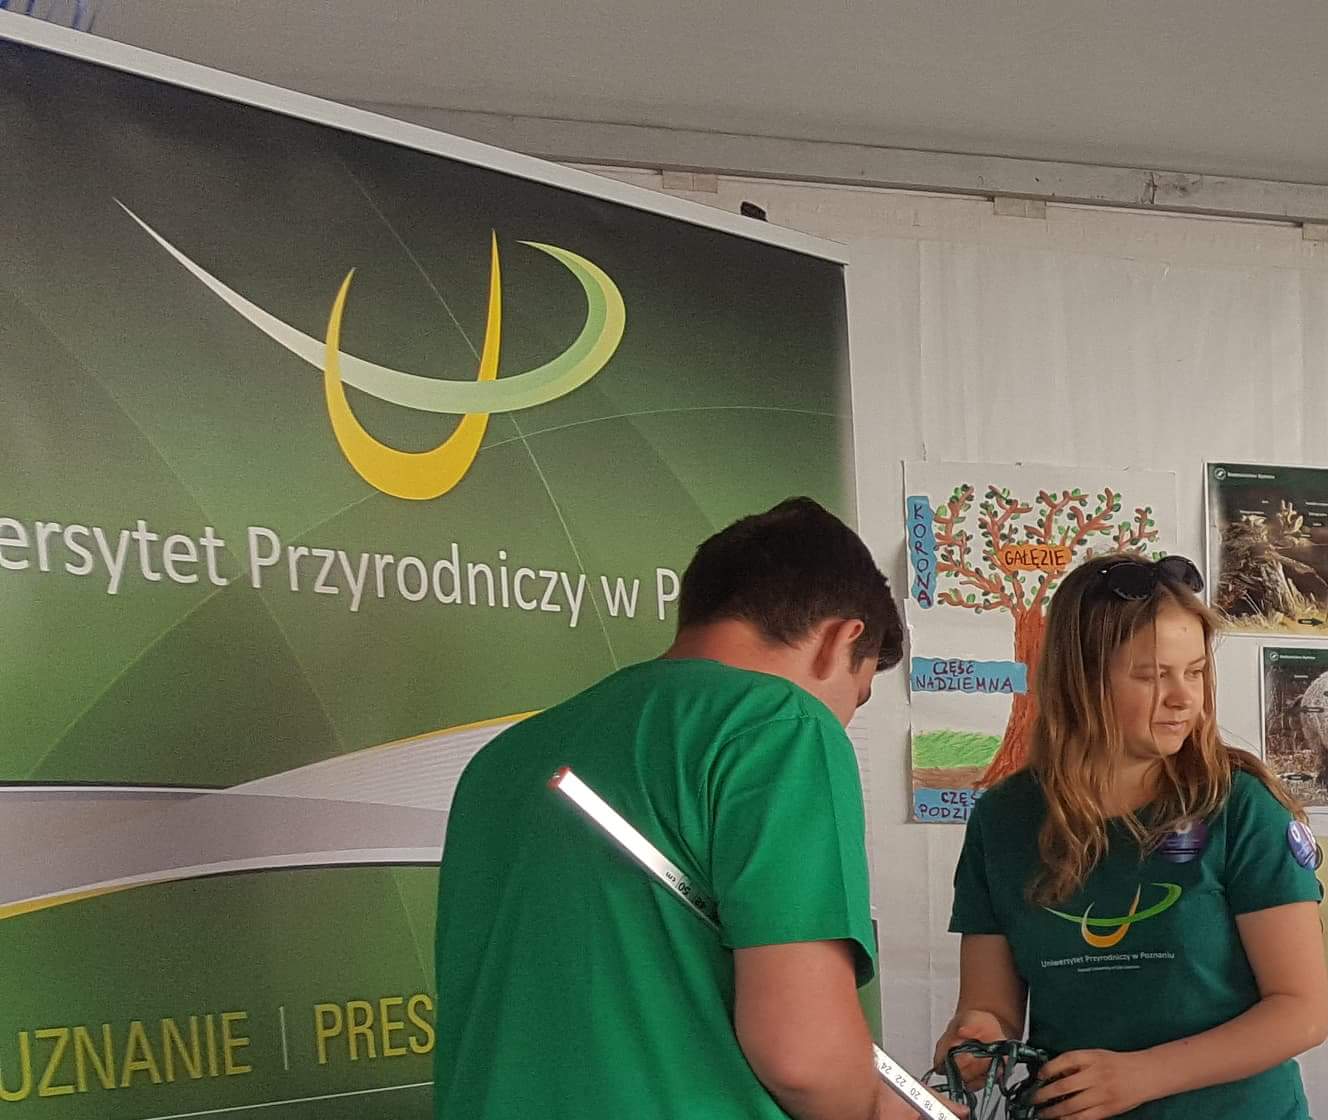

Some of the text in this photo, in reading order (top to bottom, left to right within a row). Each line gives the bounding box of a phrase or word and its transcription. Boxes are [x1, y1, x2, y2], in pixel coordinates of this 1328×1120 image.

[248, 526, 586, 627] Przyrodniczy
[601, 575, 640, 618] w
[913, 503, 932, 607] KORONA
[1005, 549, 1065, 568] GAŁĘZIE
[916, 675, 1013, 692] NADZIEMNA
[0, 1010, 252, 1102] UZNANIE
